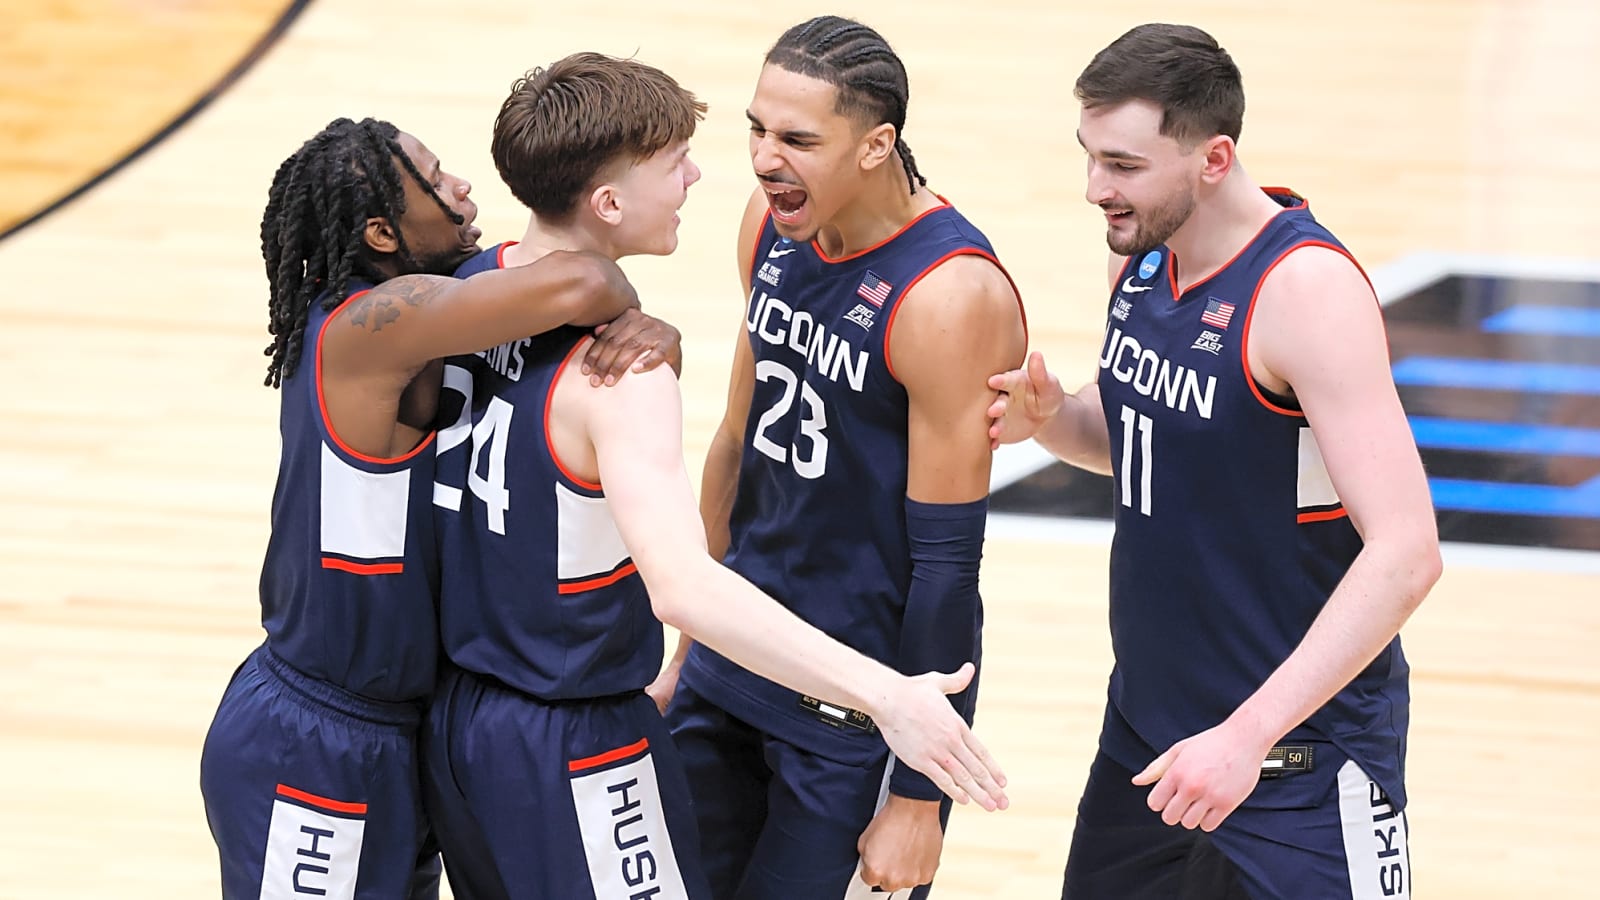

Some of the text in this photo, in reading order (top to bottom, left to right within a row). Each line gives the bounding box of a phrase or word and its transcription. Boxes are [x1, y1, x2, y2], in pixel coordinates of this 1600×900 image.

[847, 310, 874, 328] EAST
[854, 303, 875, 319] BIG
[747, 286, 869, 392] UCONN
[1194, 337, 1223, 352] EAST
[1200, 330, 1222, 343] BIG
[1100, 321, 1217, 419] UCONN
[753, 359, 828, 479] 23
[1120, 404, 1153, 516] 11
[1288, 752, 1302, 763] 50
